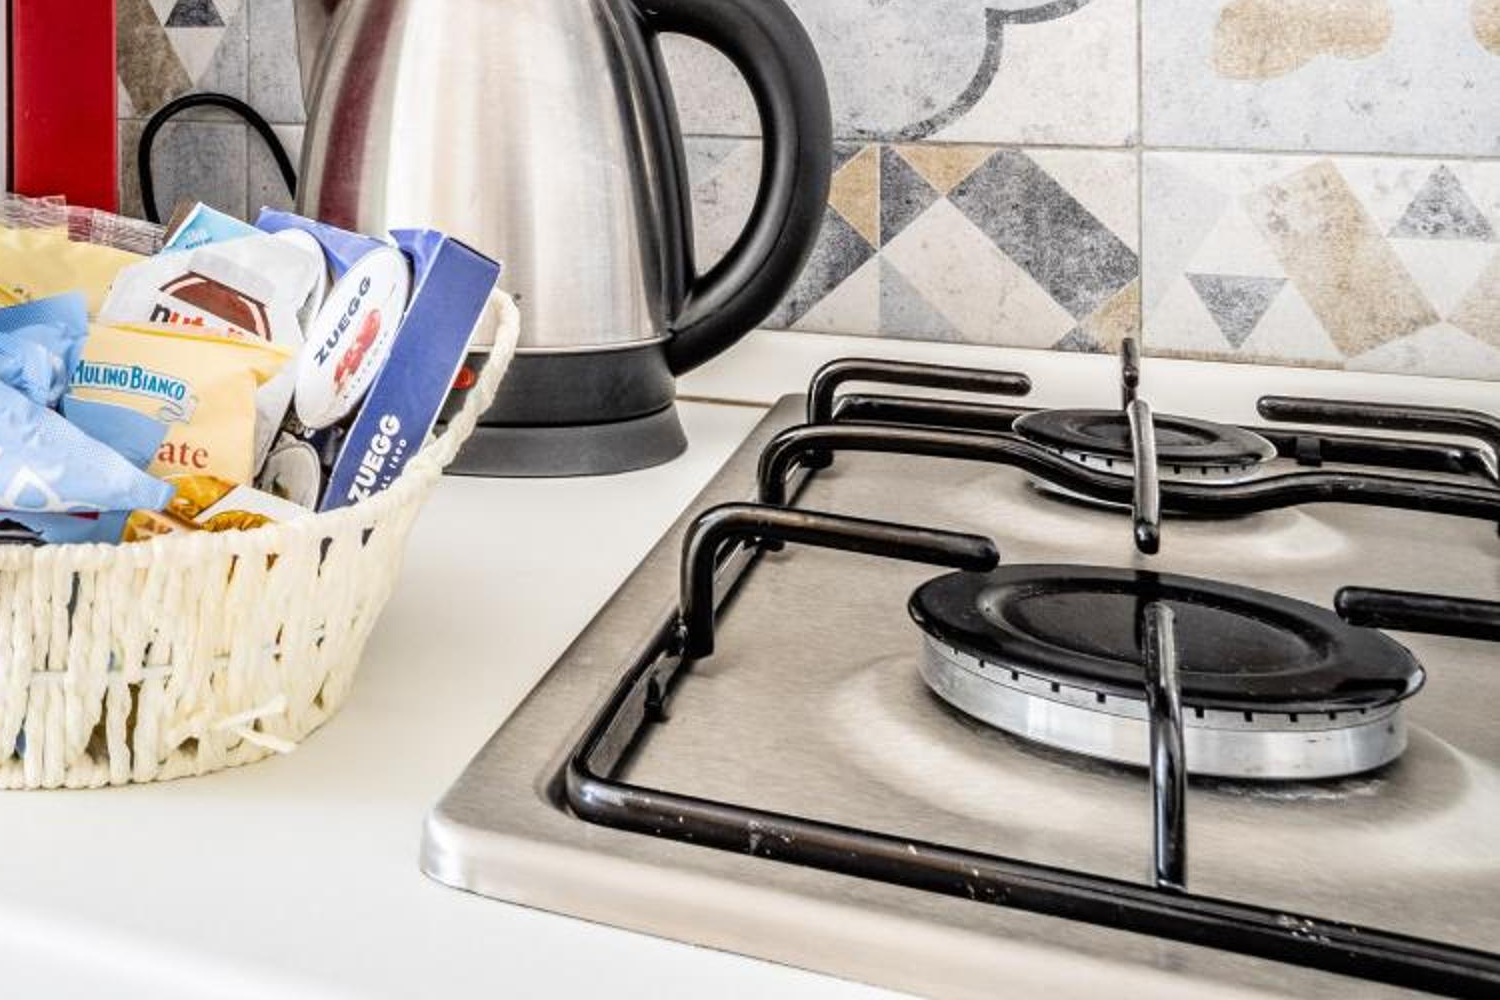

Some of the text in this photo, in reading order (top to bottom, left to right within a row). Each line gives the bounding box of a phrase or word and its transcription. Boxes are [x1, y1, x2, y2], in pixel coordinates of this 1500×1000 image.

[314, 276, 372, 368] ZUEGG
[157, 441, 209, 469] ate
[347, 414, 401, 502] ZUEGG
